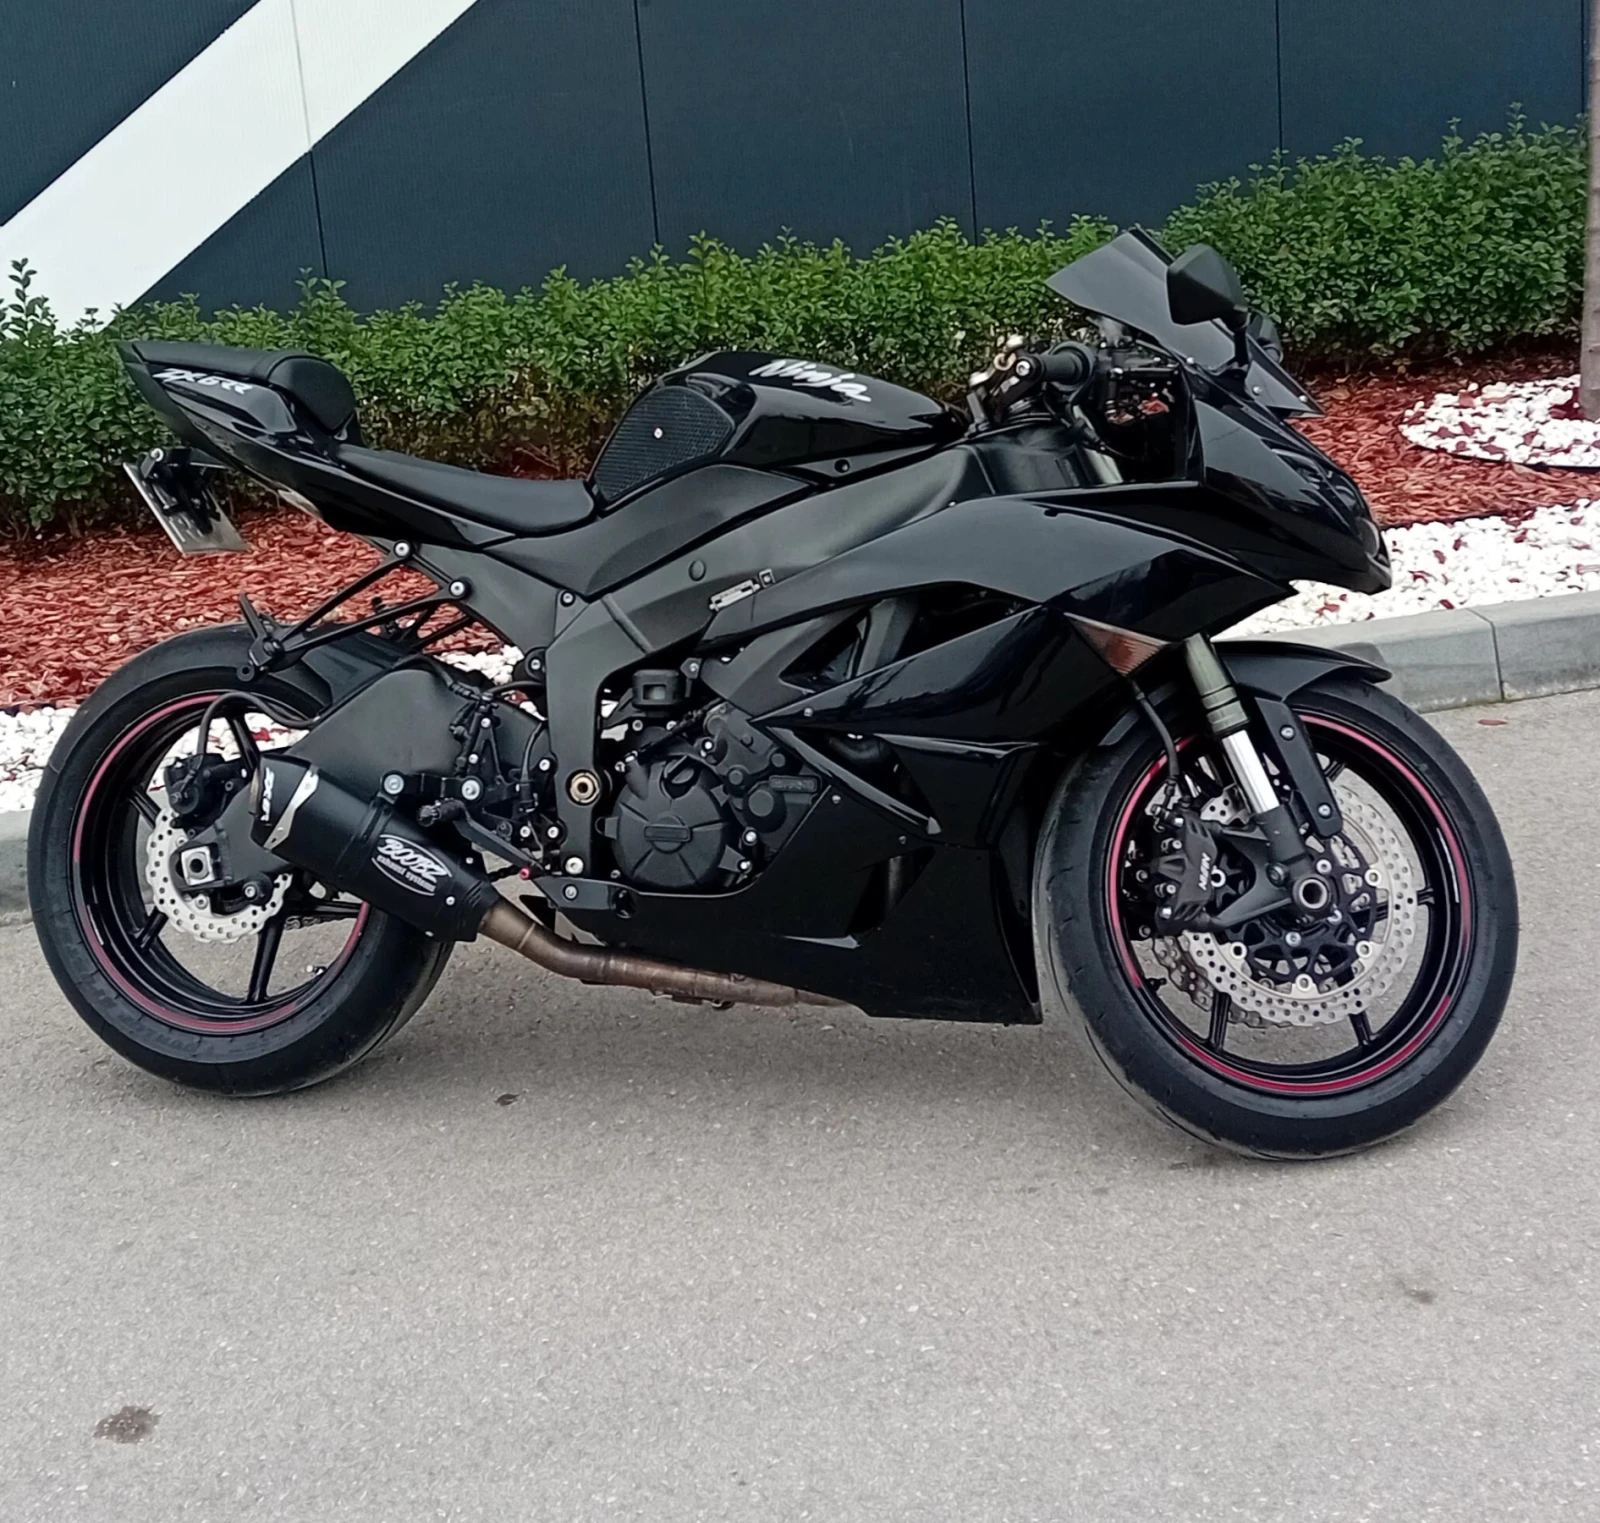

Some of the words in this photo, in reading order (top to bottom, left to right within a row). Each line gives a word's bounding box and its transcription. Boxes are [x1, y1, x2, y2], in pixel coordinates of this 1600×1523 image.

[748, 360, 871, 402] Ninja
[376, 854, 407, 875] exhaust
[405, 871, 436, 892] systems
[377, 838, 447, 883] BOOBZ
